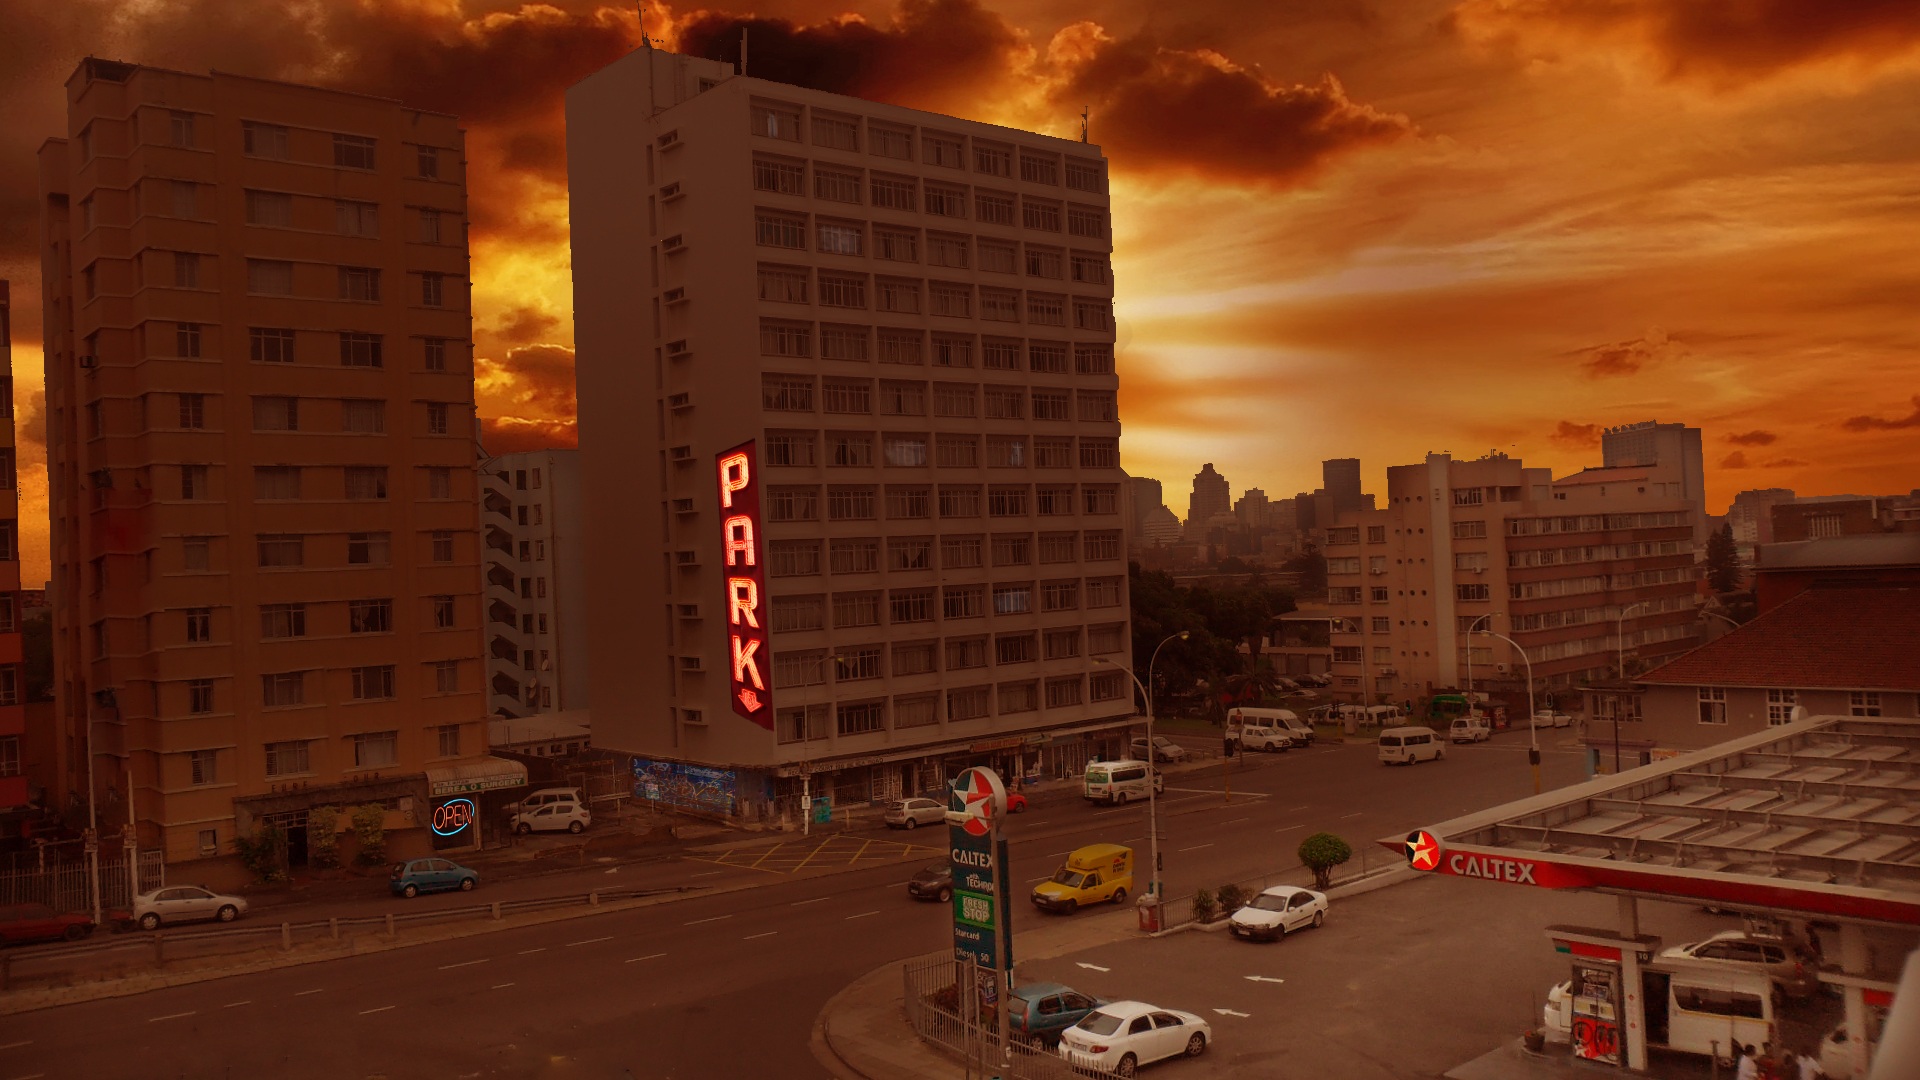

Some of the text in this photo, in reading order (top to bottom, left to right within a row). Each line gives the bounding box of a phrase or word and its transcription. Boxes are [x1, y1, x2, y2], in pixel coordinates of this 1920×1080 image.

[720, 453, 766, 692] PARK
[434, 785, 467, 795] BEREA
[480, 778, 522, 789] SURGERY
[433, 803, 472, 830] OPEN
[952, 848, 993, 868] CALTEX
[1450, 854, 1537, 885] CALTEX
[962, 896, 989, 910] FRESH
[962, 909, 990, 922] STOP
